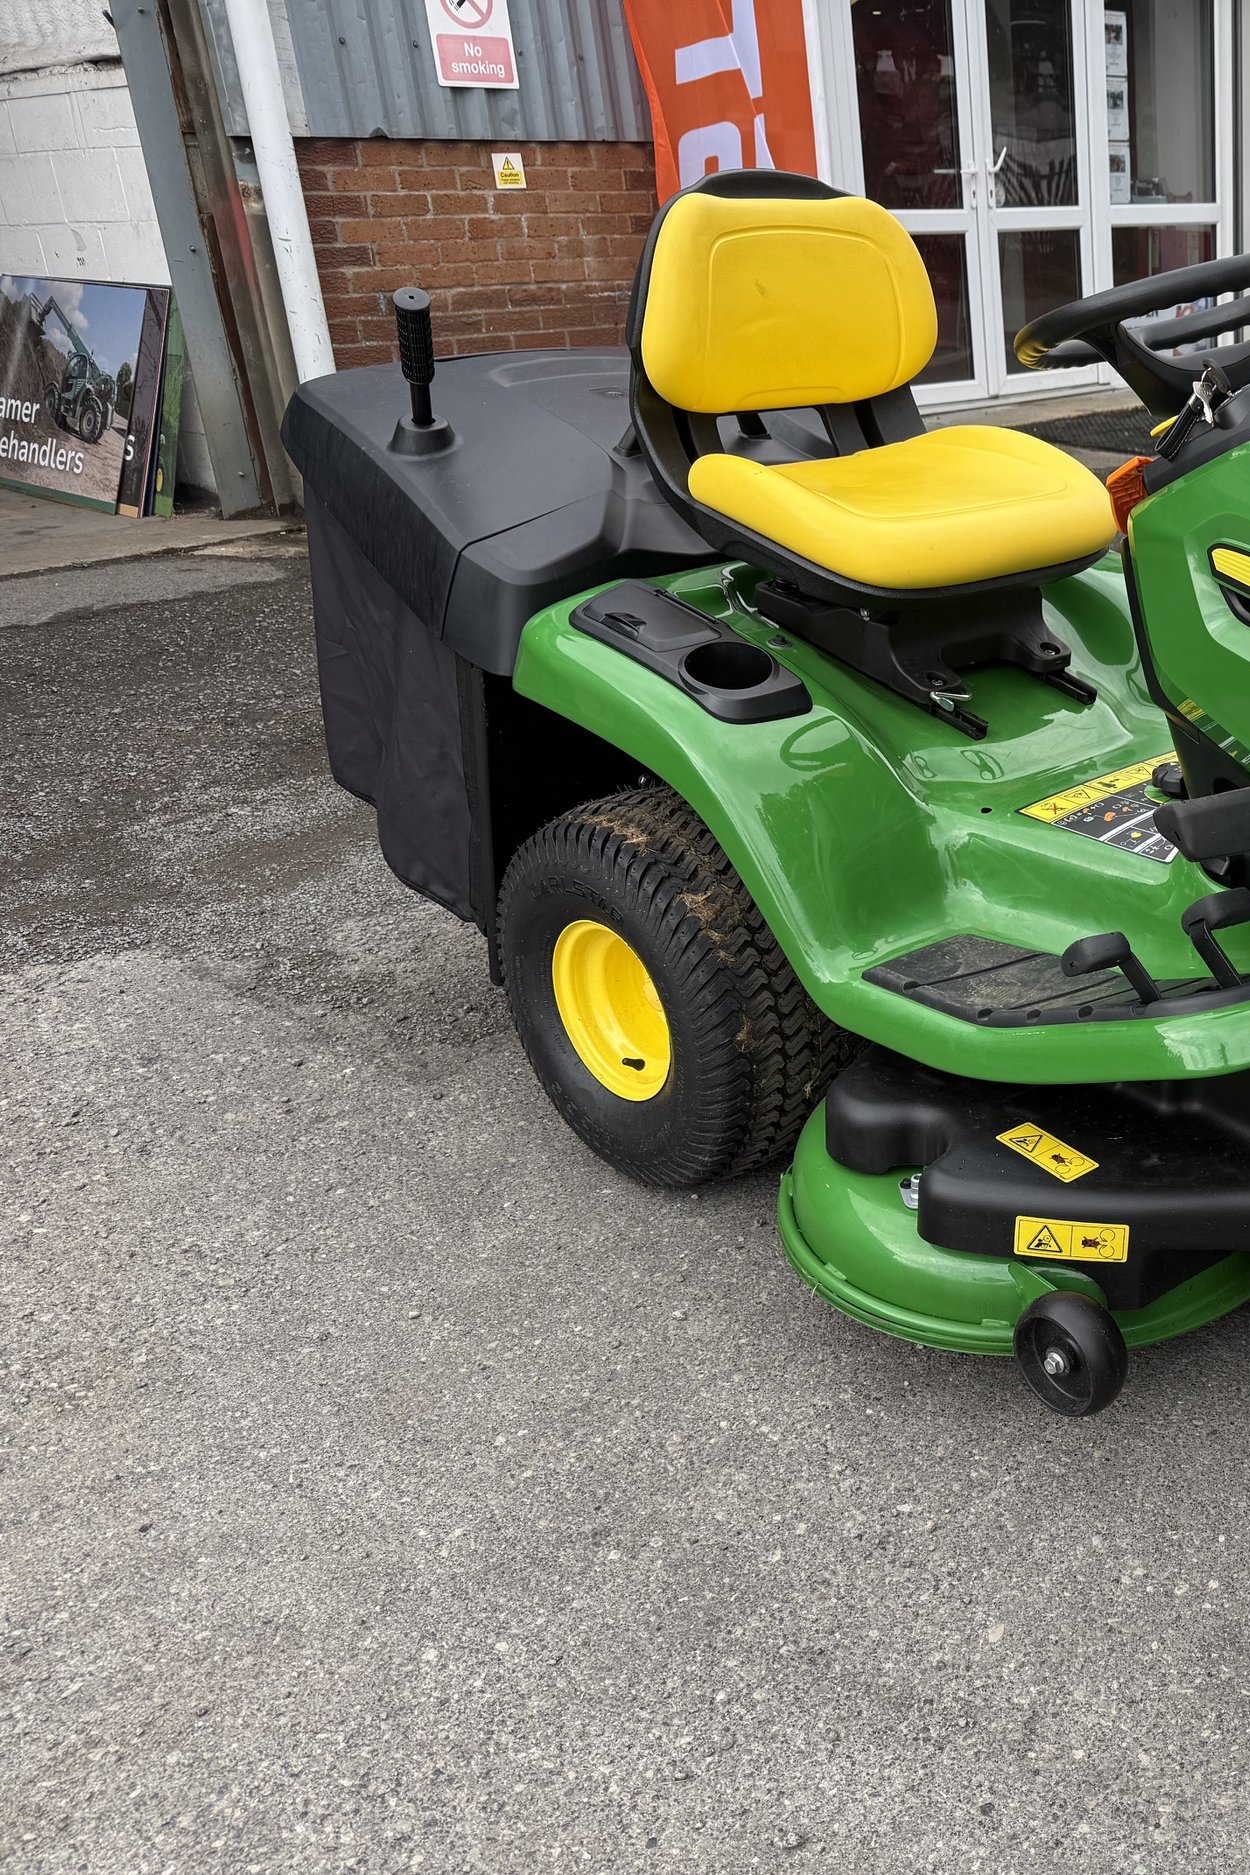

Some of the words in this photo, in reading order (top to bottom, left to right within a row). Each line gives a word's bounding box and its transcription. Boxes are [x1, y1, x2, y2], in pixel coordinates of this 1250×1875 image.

[463, 42, 483, 57] No
[451, 60, 505, 78] smoking
[0, 430, 84, 474] ehandlers
